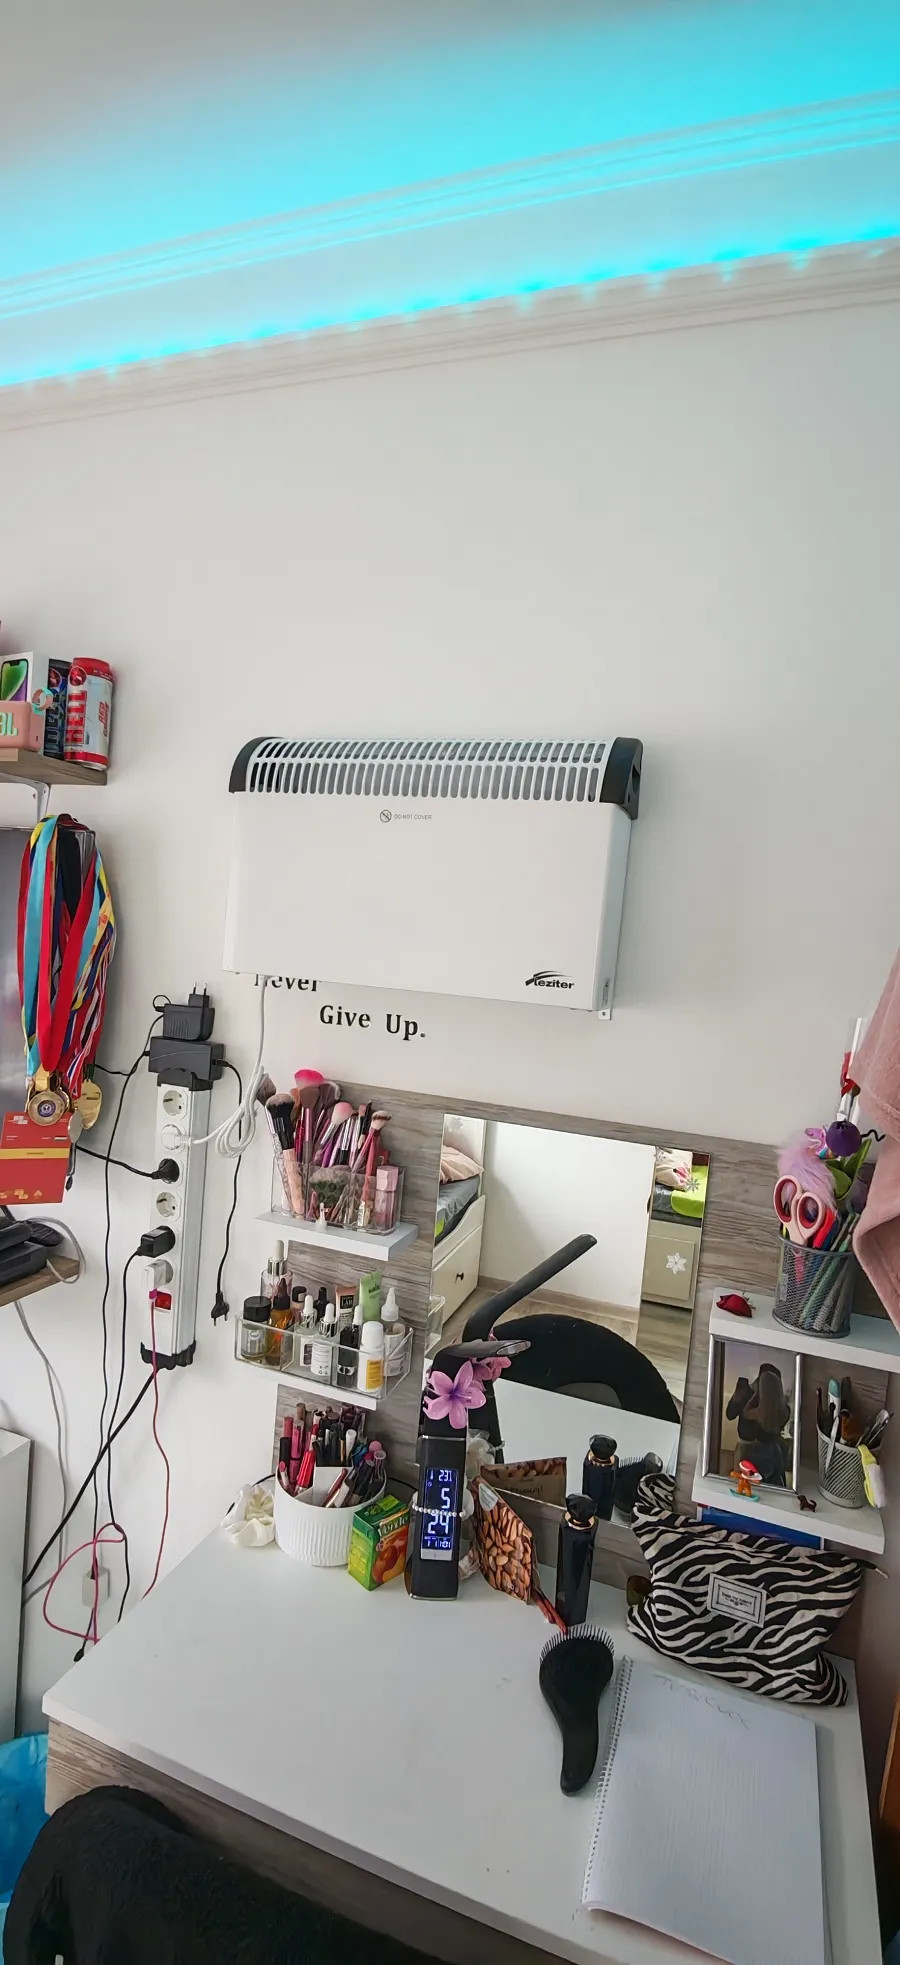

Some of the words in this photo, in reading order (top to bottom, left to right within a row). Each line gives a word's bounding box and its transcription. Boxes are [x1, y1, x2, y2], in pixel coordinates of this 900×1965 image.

[65, 690, 87, 744] HELL
[319, 1004, 371, 1029] Give
[386, 1013, 426, 1042] Up.
[440, 1487, 451, 1509] 5
[427, 1511, 450, 1534] 24
